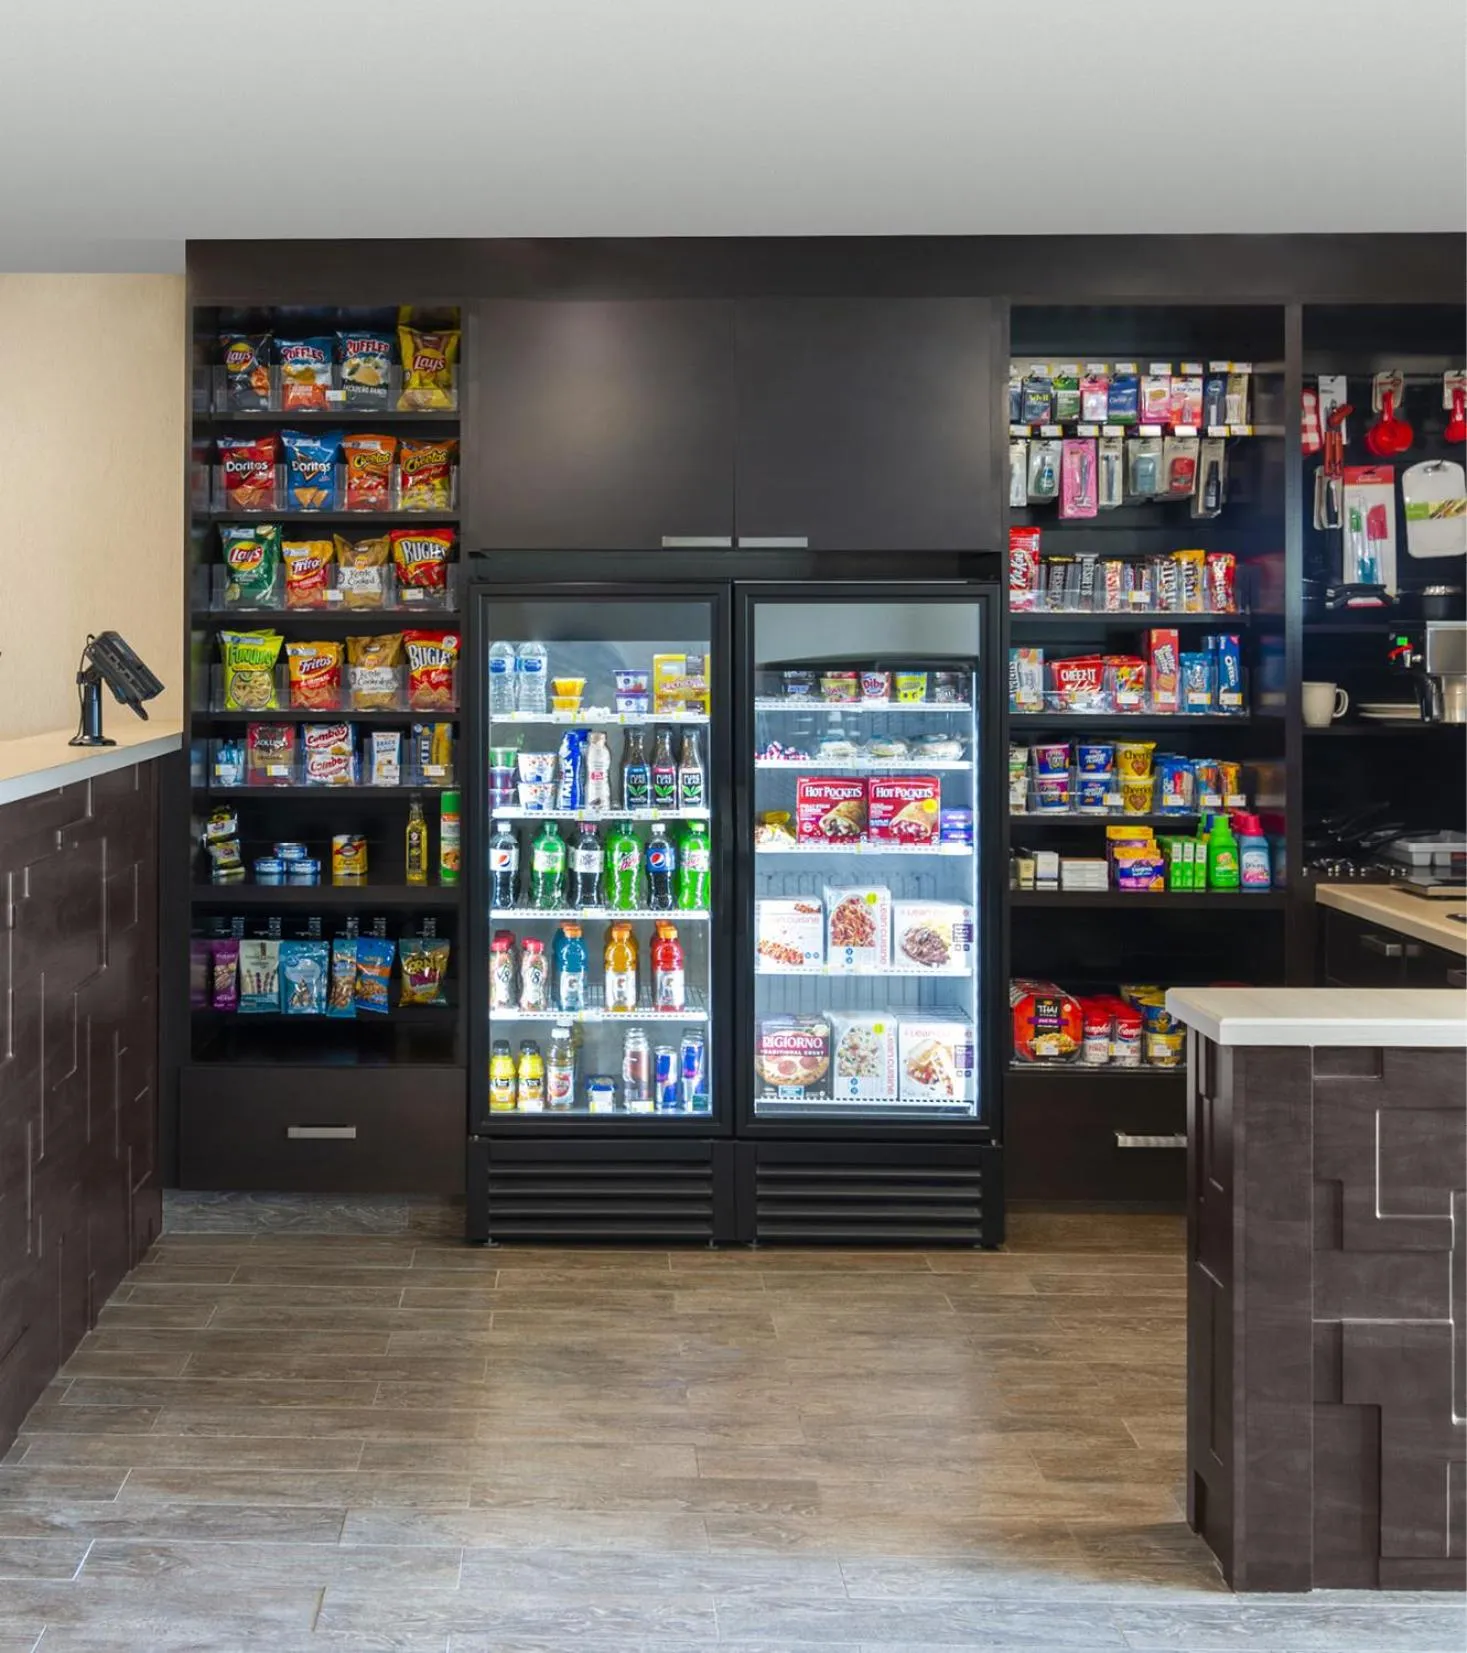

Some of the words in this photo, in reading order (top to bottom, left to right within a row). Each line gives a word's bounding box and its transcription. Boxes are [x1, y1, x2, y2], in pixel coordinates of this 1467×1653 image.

[226, 461, 267, 472] Doritos
[292, 461, 331, 473] Doritos
[231, 548, 262, 563] Lay's
[805, 786, 825, 797] HOT
[825, 786, 863, 798] POCKETS
[876, 787, 895, 798] HOT
[895, 787, 934, 798] POCKETS
